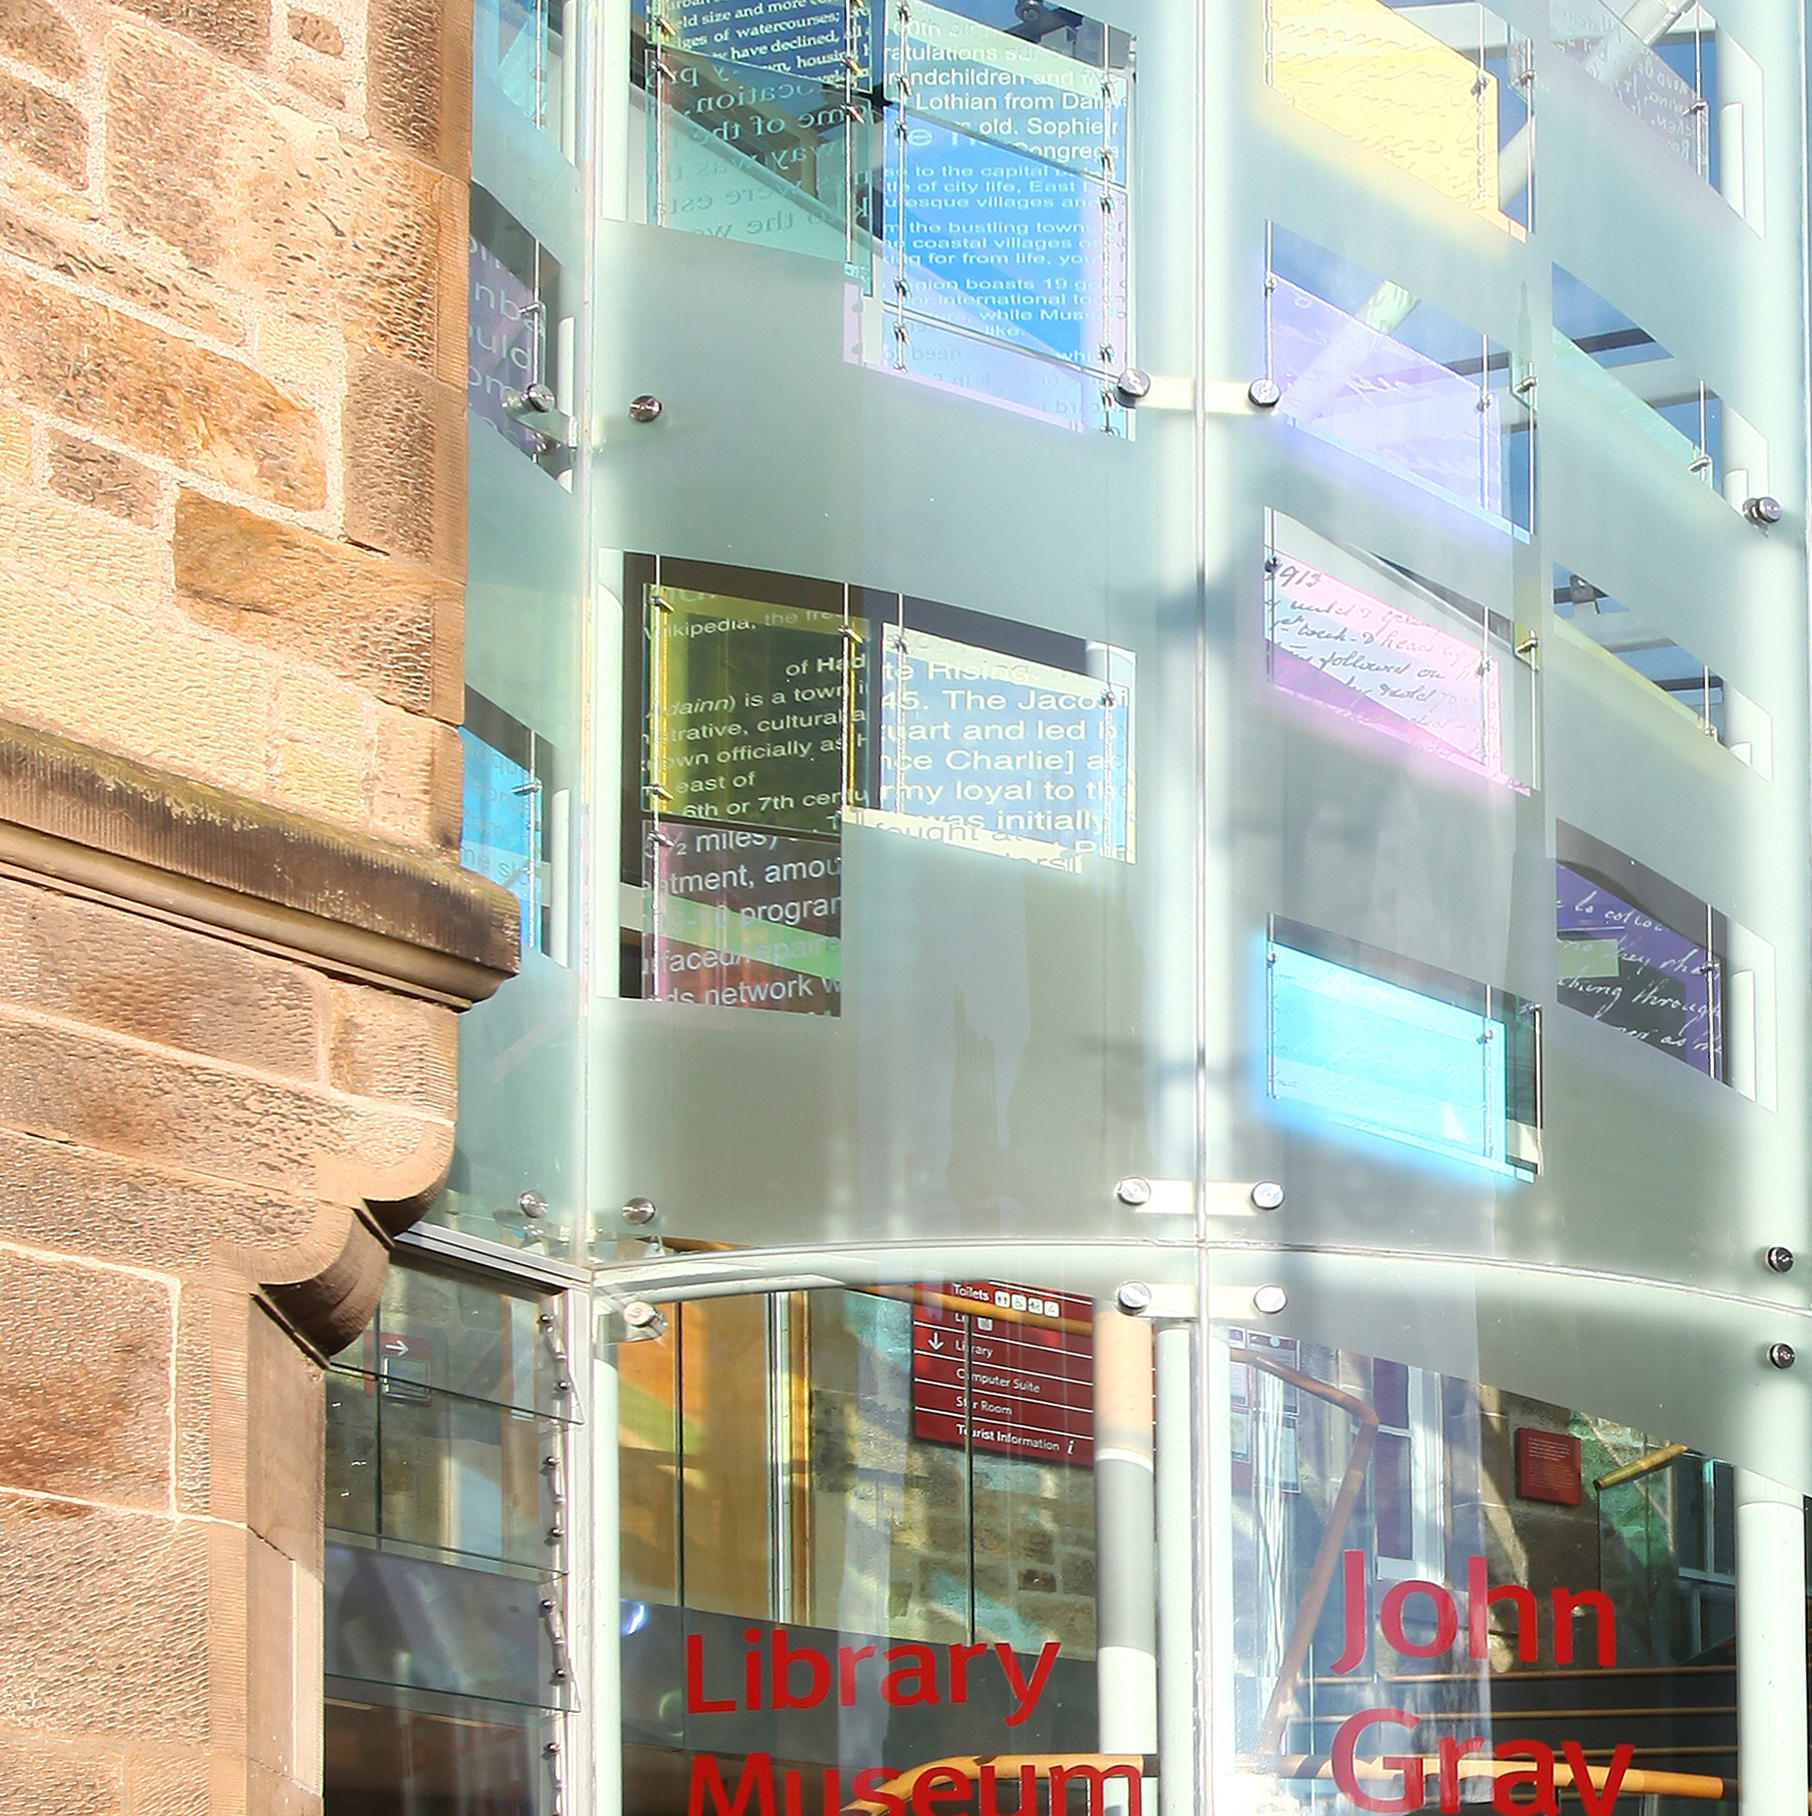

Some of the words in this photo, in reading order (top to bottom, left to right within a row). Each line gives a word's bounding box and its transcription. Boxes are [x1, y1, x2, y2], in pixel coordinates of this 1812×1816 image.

[702, 9, 731, 24] size
[734, 1, 764, 18] and
[713, 27, 730, 44] of
[735, 10, 840, 40] watercourses;
[731, 42, 769, 61] have
[770, 29, 840, 52] declined,
[915, 92, 997, 111] Lothian
[1004, 91, 1054, 110] from
[980, 118, 1018, 135] old.
[1027, 118, 1104, 139] Sophie
[916, 165, 934, 178] to
[942, 165, 974, 178] the
[980, 165, 1049, 180] capital
[917, 180, 938, 193] of
[944, 180, 978, 195] city
[1029, 180, 1076, 194] East
[976, 195, 1057, 210] villages
[909, 220, 942, 234] the
[948, 220, 1029, 236] bustling
[912, 236, 987, 250] coastal
[994, 236, 1072, 251] villages
[928, 252, 956, 265] for
[962, 252, 1009, 265] from
[965, 277, 1035, 290] boasts
[938, 292, 1066, 305] international
[979, 308, 1034, 321] while
[786, 658, 809, 677] of
[927, 659, 1040, 684] Rising.
[744, 691, 763, 708] is
[771, 690, 787, 705] a
[942, 689, 1006, 711] The
[962, 720, 1025, 741] and
[1036, 719, 1086, 741] led
[716, 739, 812, 764] officially
[945, 749, 1075, 776] Charlie]
[674, 774, 727, 794] east
[732, 770, 757, 788] of
[955, 779, 1032, 805] loyal
[1043, 780, 1075, 801] to
[725, 799, 750, 816] or
[757, 795, 795, 813] 7th
[704, 974, 815, 1006] network
[953, 1283, 990, 1302] Toilets
[955, 1339, 994, 1359] Lirary
[956, 1368, 1012, 1389] Cmputer
[1013, 1378, 1041, 1394] Suite
[981, 1399, 1013, 1416] Room
[997, 1432, 1061, 1452] Information
[1330, 1548, 1618, 1675] John
[685, 1626, 1061, 1727] Library
